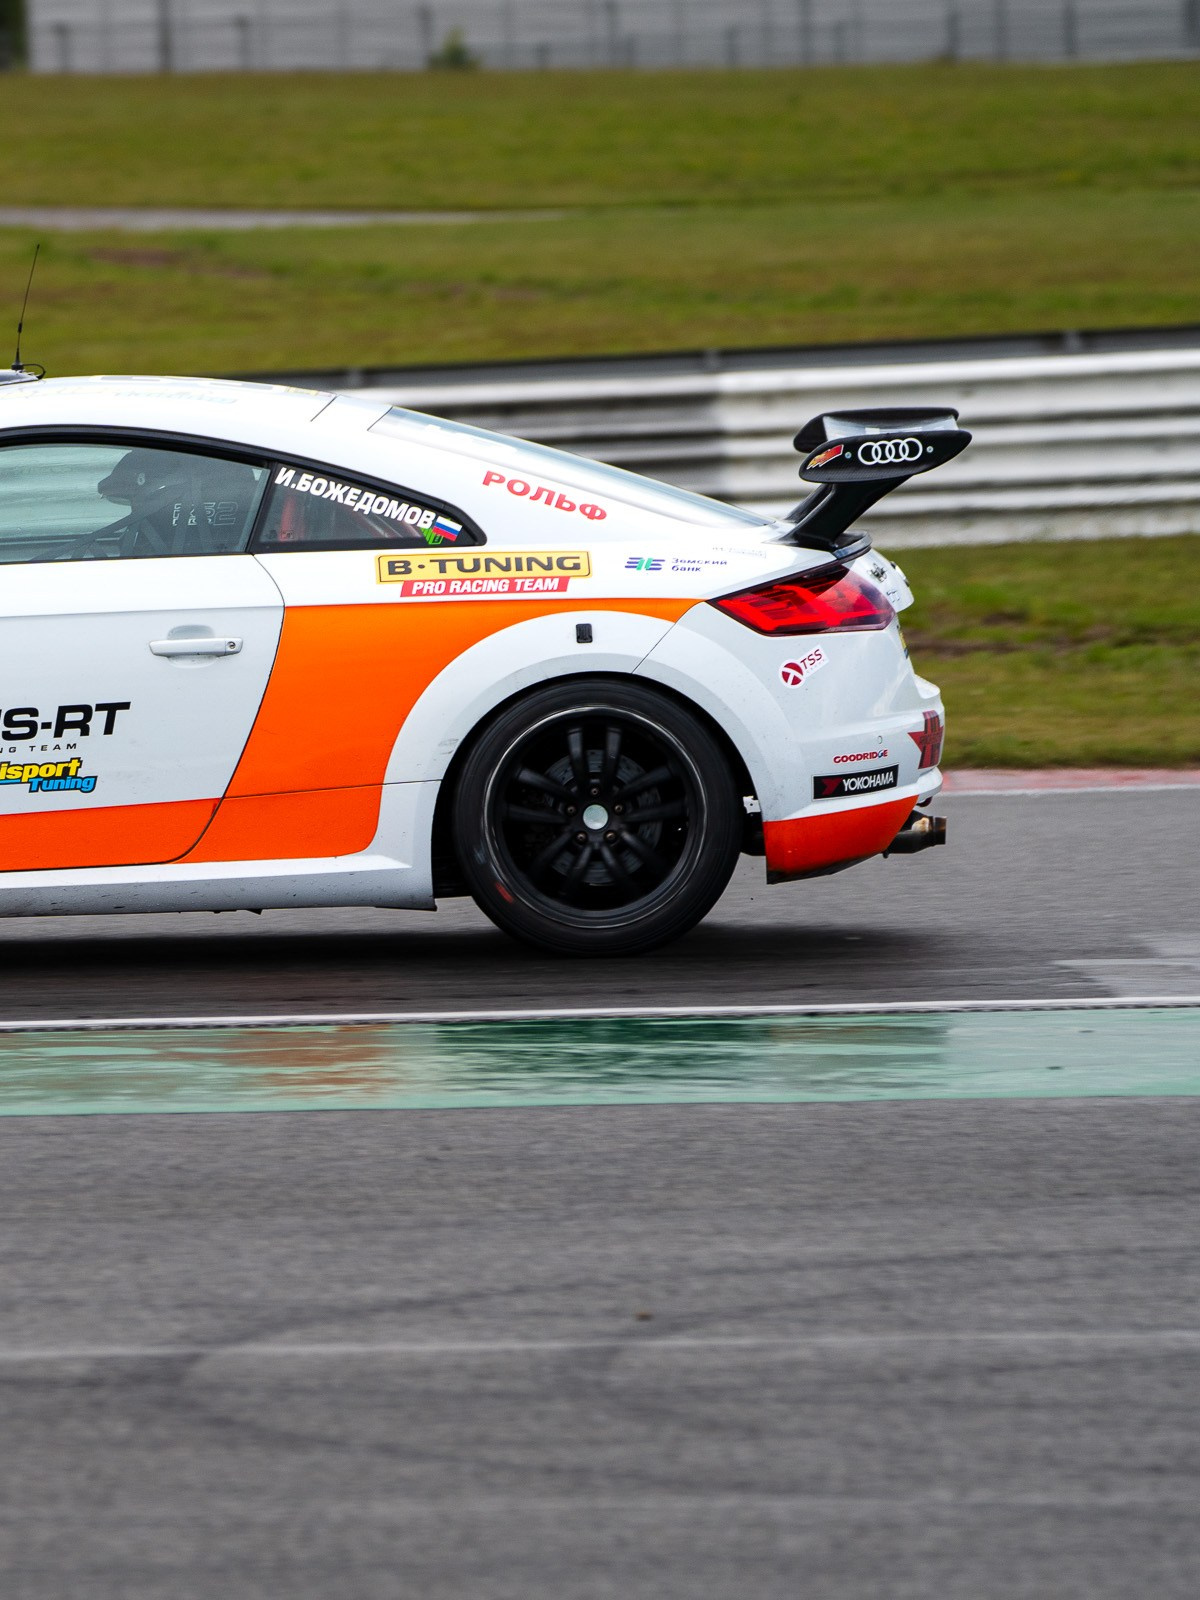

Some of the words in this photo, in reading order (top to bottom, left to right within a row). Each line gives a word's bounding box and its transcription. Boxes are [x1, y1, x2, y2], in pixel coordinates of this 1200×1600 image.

[274, 466, 437, 530] И.БОЖЕДОМОВ
[482, 470, 608, 521] РОЛЬФ
[411, 580, 446, 595] PRO
[449, 578, 510, 593] RACING
[514, 577, 560, 592] TEAM
[799, 648, 823, 670] TSS
[29, 743, 78, 752] TEAM
[833, 749, 889, 764] GOODRIDGE
[28, 775, 99, 794] Tuning
[842, 771, 895, 792] YOKOHAMA
